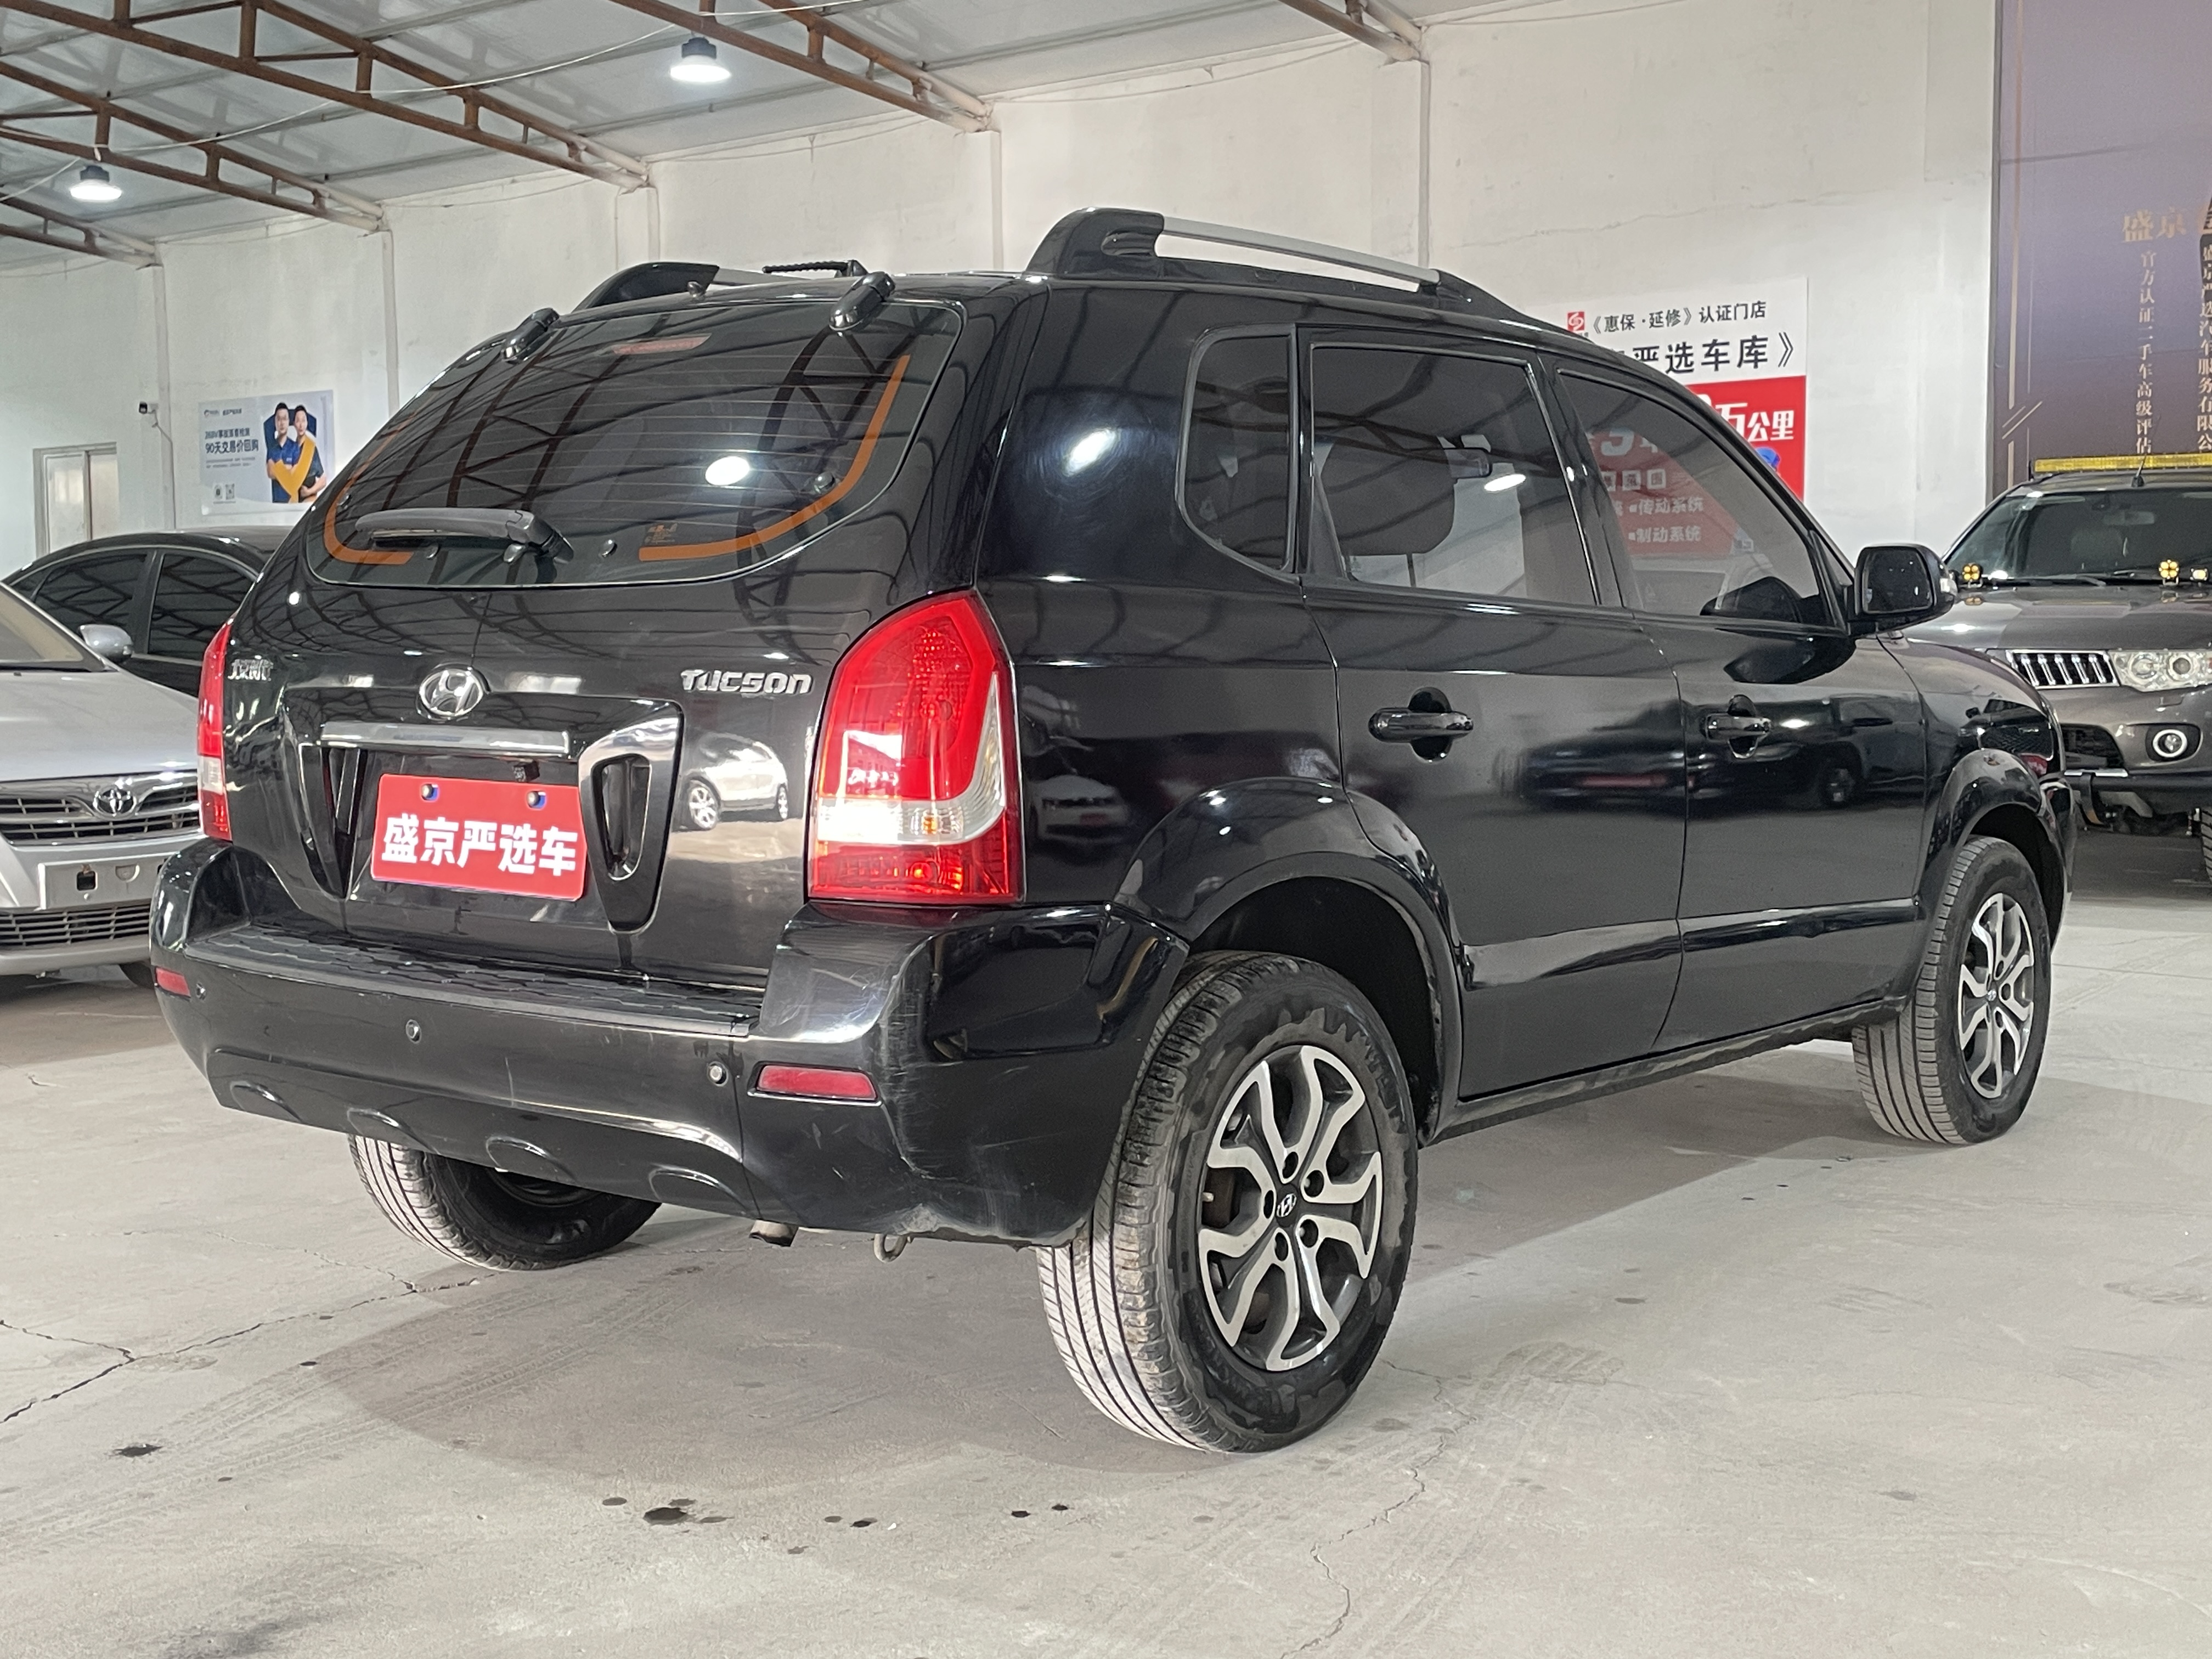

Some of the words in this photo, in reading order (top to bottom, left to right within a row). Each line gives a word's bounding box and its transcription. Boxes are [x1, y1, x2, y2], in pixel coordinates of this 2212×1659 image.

[1618, 331, 1794, 374] 严选车库》
[1697, 394, 1794, 442] 万公里
[680, 669, 812, 694] TUCSON
[381, 812, 578, 877] 盛京严选车
